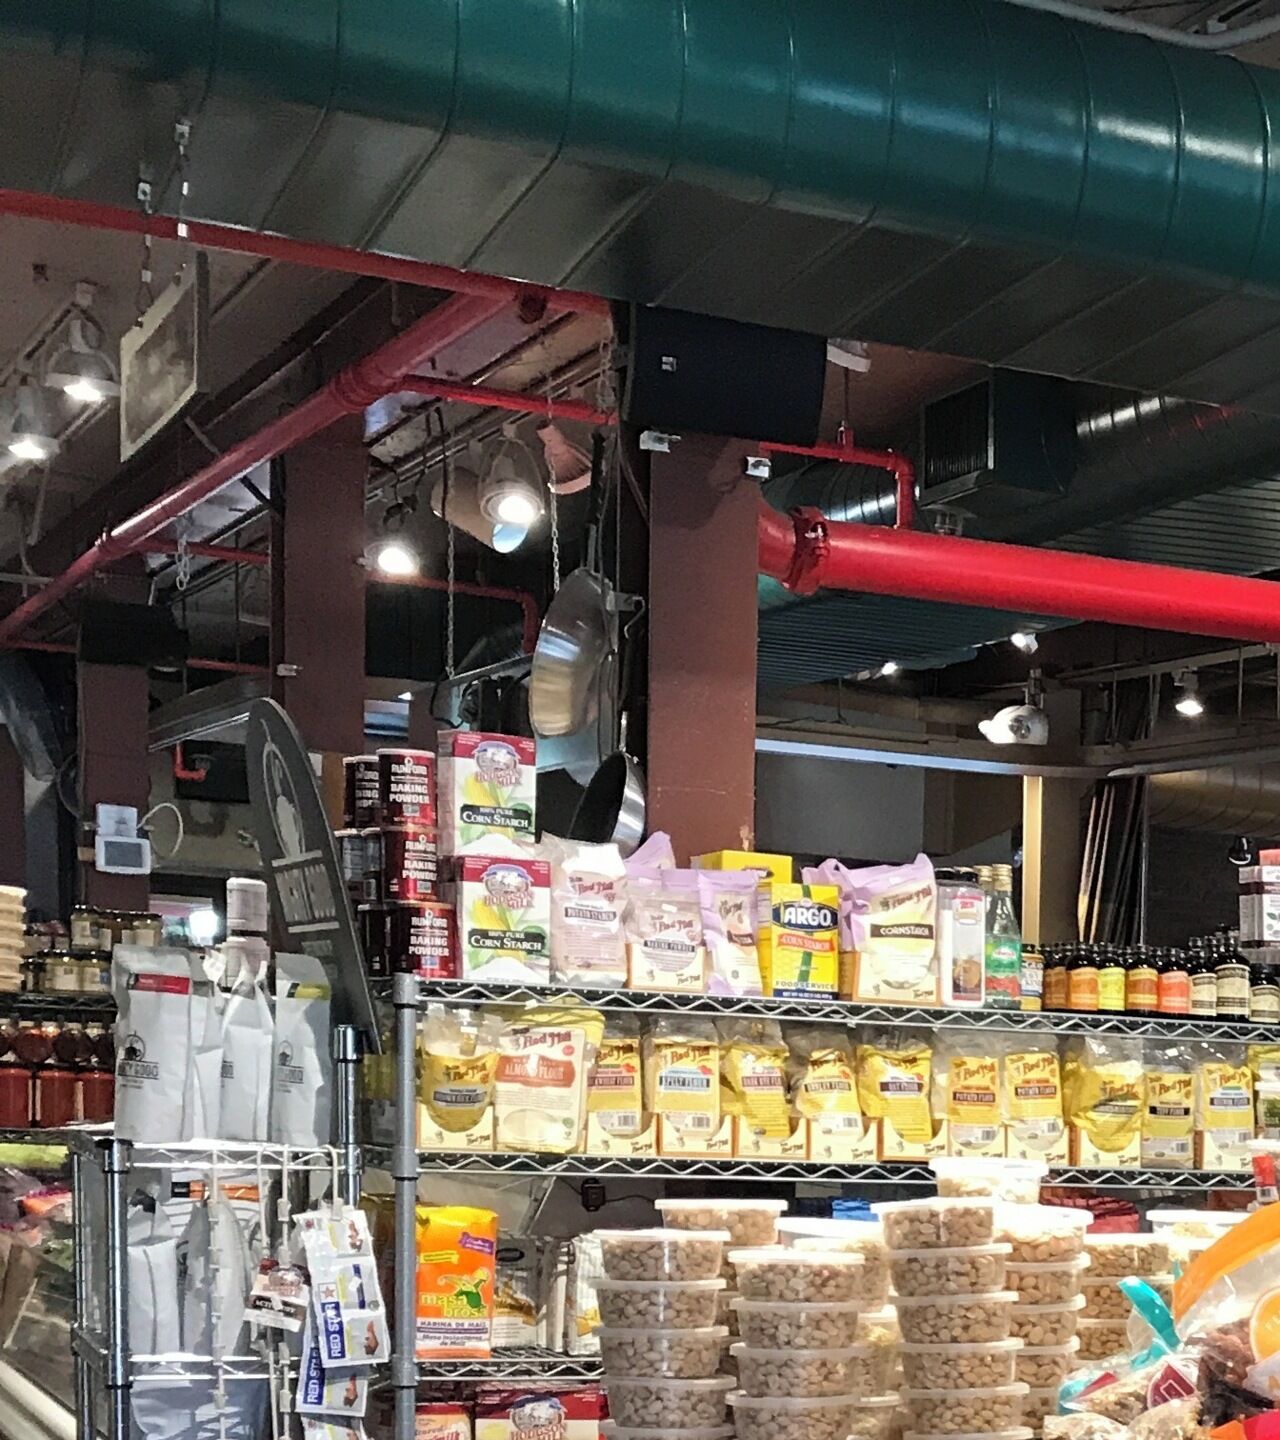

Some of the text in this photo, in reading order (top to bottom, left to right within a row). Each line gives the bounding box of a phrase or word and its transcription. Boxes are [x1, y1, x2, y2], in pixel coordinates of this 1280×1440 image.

[390, 783, 429, 795] BAKING
[389, 793, 430, 805] POWDER
[462, 811, 529, 828] CORN STARCH
[783, 907, 831, 927] ARGO
[410, 935, 448, 947] BAKING
[471, 935, 542, 951] CORN STARCH
[408, 945, 450, 957] POWDER
[421, 1292, 467, 1306] masa
[325, 1303, 345, 1360] RED STAR
[306, 1378, 320, 1405] RED
